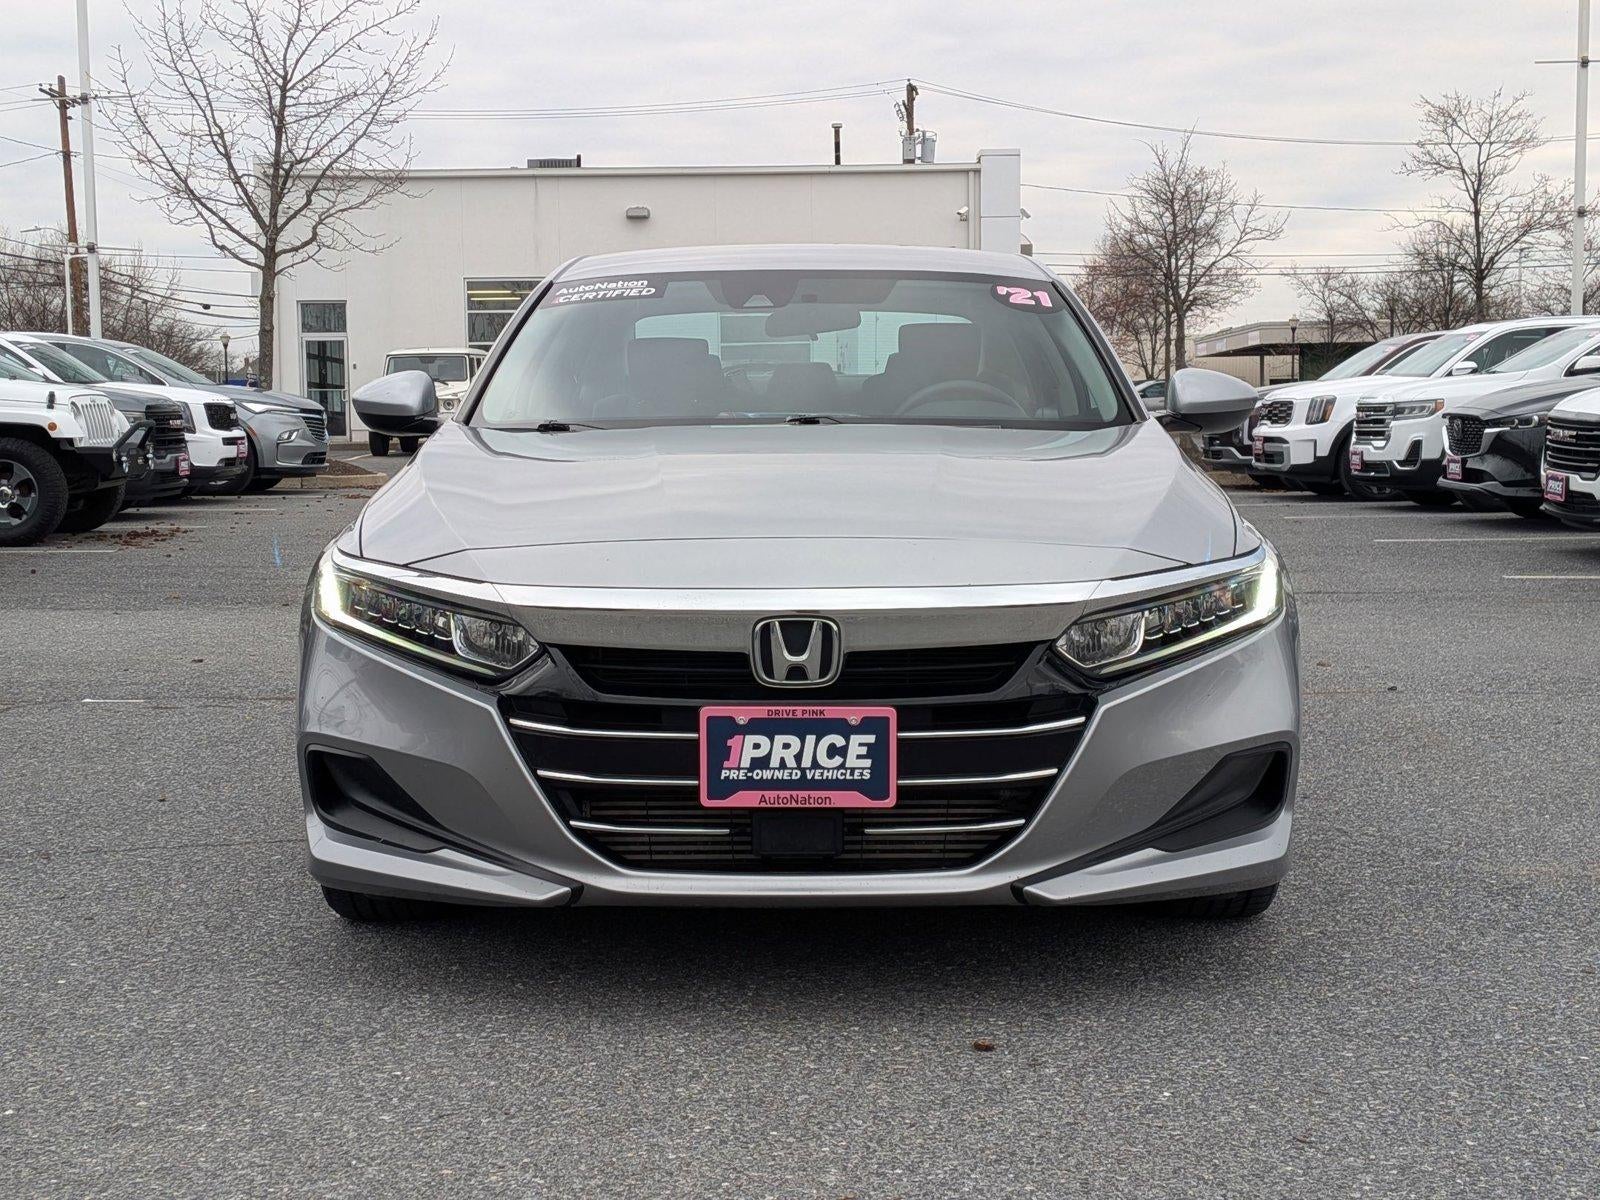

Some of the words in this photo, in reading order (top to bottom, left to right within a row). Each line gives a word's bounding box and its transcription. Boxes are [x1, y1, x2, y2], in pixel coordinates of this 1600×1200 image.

[556, 280, 648, 295] AutoNation
[767, 709, 799, 717] DRIVE
[801, 709, 826, 717] PINK
[720, 769, 801, 780] PRE-OWNED
[806, 769, 871, 780] VEHICLES
